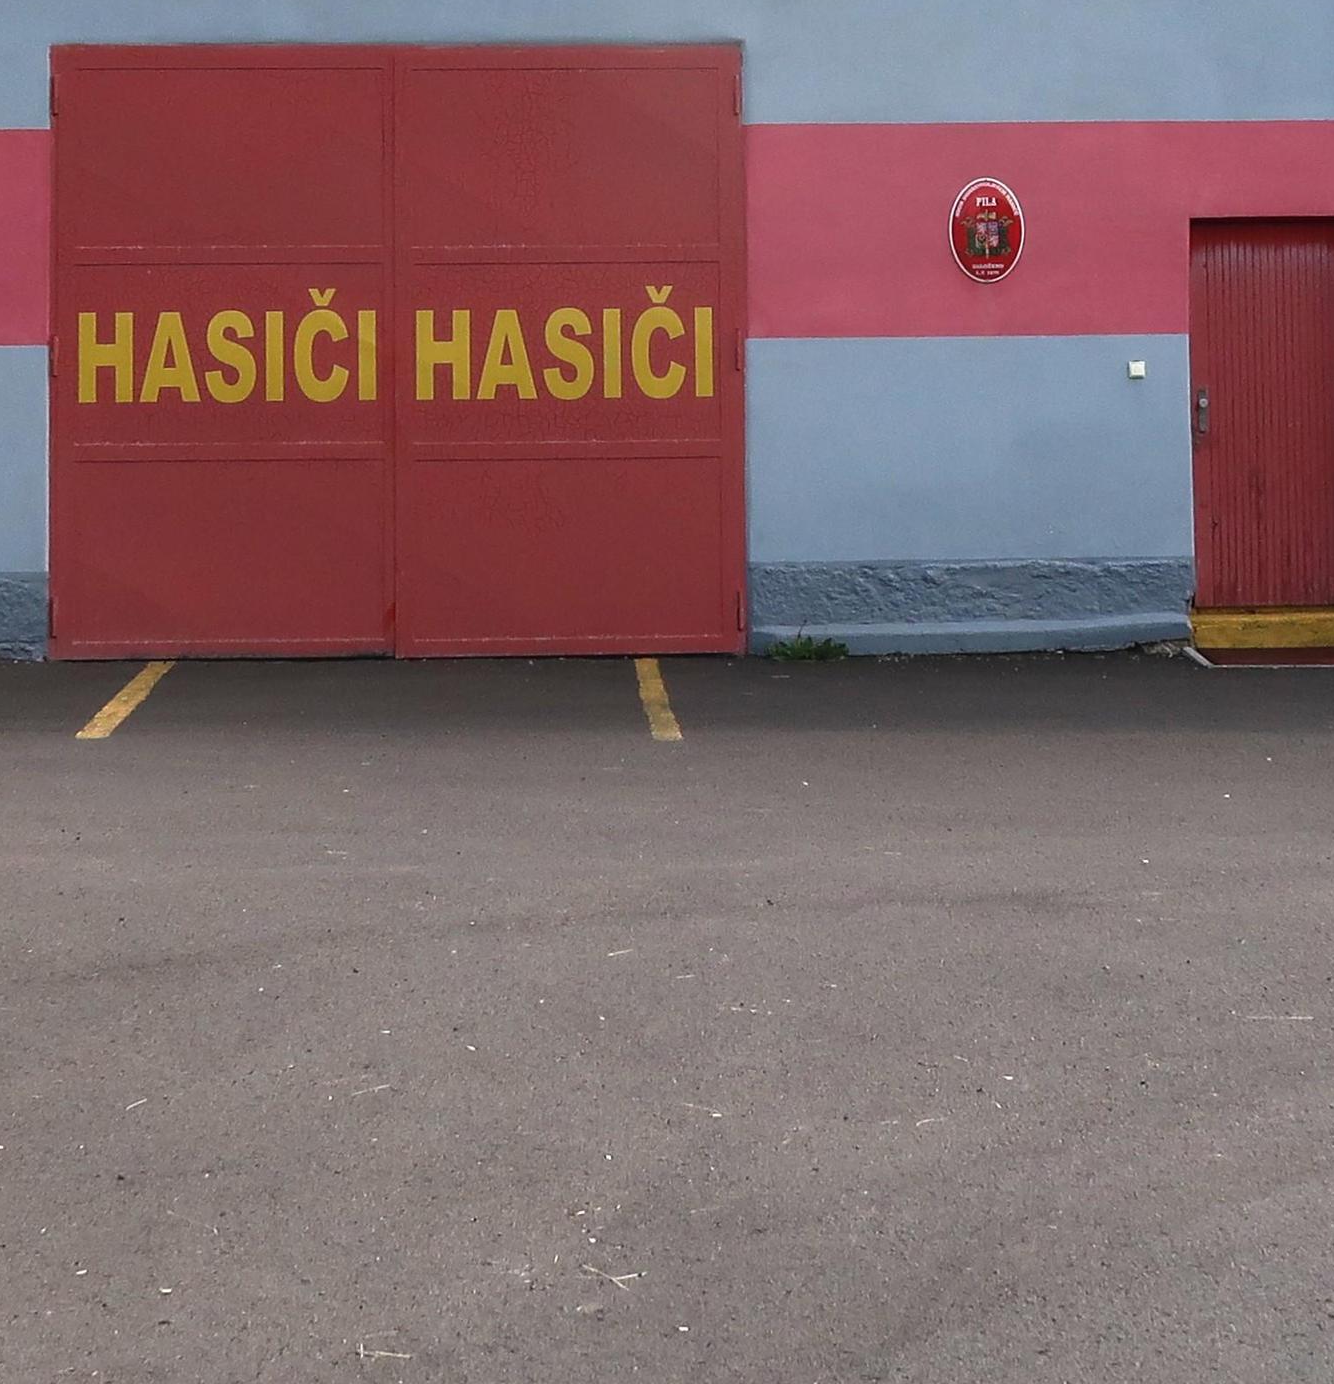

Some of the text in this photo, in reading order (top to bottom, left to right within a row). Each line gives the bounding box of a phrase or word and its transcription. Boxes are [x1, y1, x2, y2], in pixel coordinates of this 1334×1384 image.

[976, 196, 997, 207] PILA
[77, 285, 713, 403] HASIČI HASIČI
